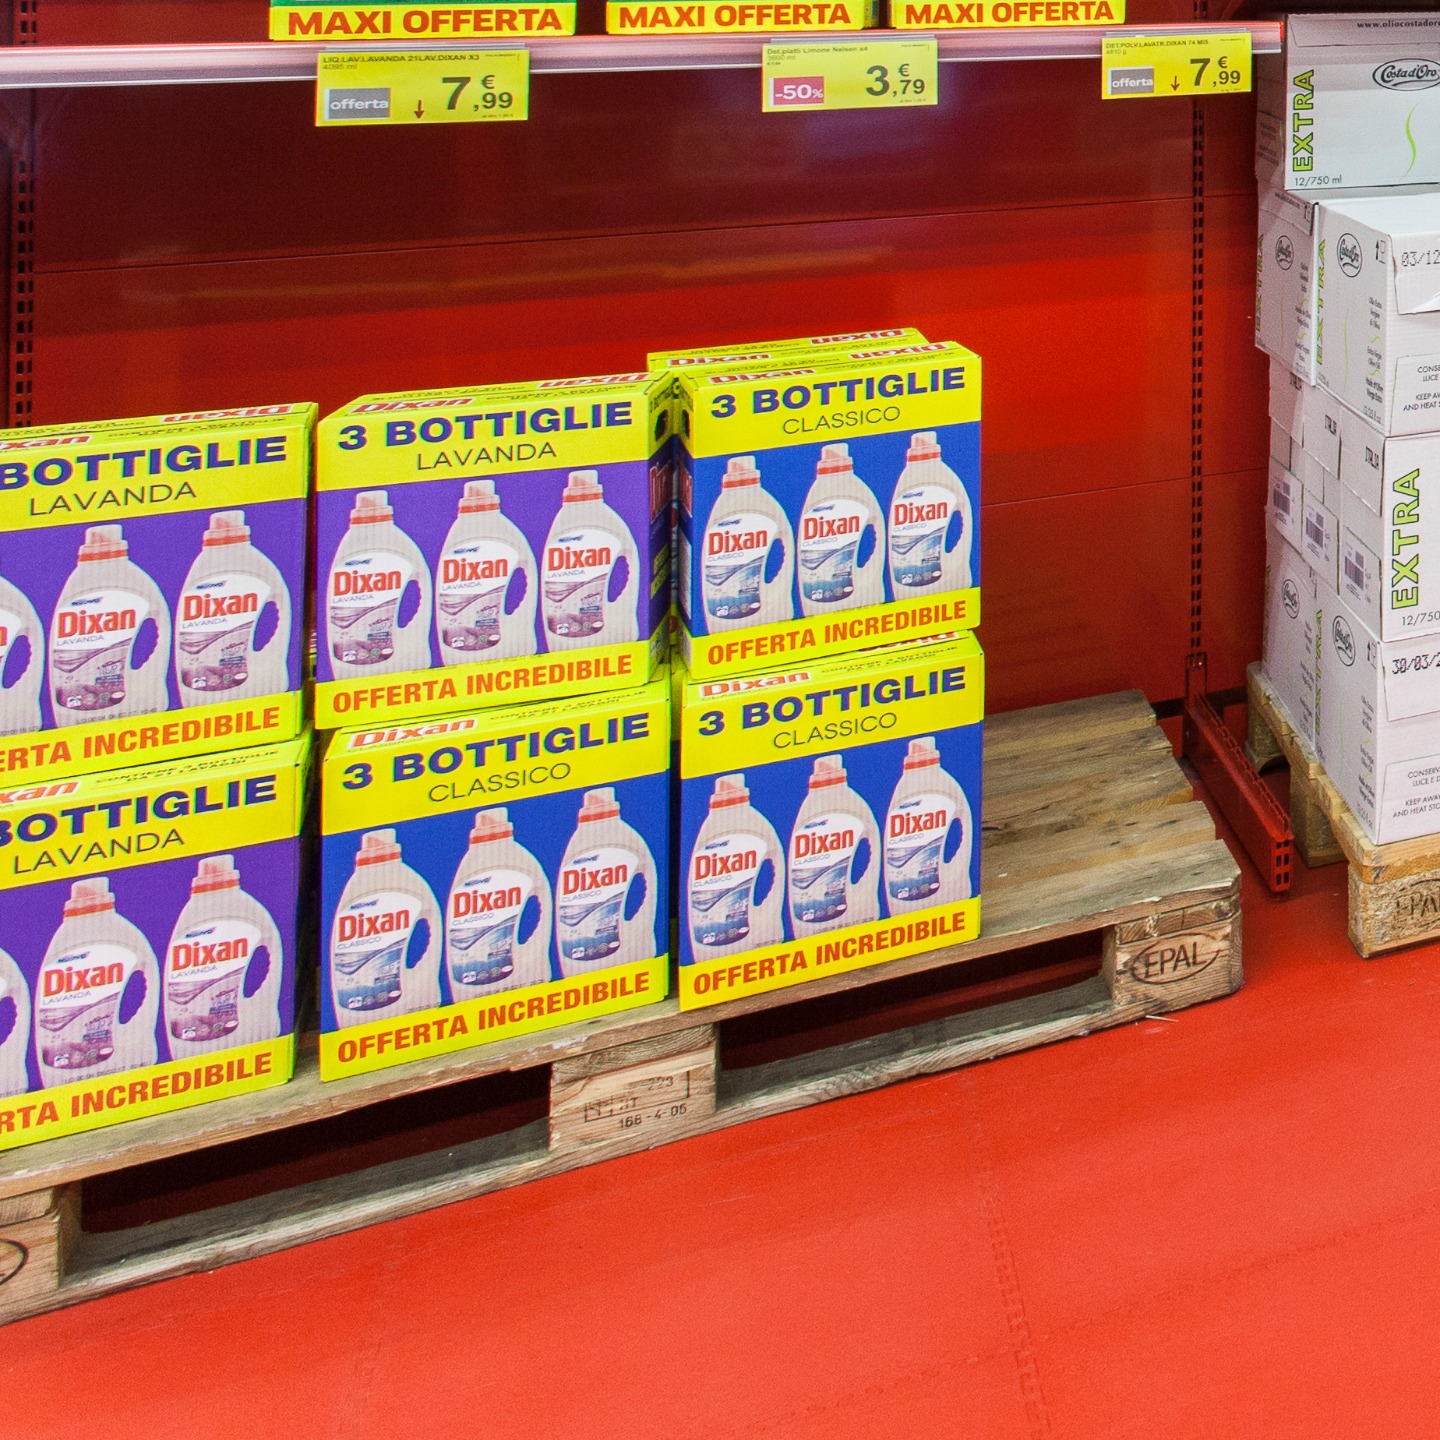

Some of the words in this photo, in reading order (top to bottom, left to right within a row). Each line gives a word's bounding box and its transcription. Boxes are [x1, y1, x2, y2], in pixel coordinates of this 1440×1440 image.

[288, 9, 392, 35] MAXI
[402, 7, 563, 34] OFFERTA
[905, 2, 984, 25] MAXI
[992, 0, 1115, 23] OFFERTA
[1111, 75, 1154, 90] offerta
[330, 98, 389, 110] offerta
[1292, 69, 1314, 173] EXTRA
[711, 394, 737, 420] 3
[752, 366, 966, 414] BOTTIGLIE
[782, 407, 902, 435] CLASSICO
[29, 479, 198, 517] LAVANDA
[708, 528, 768, 556] Dixan
[708, 627, 816, 666] OFFERTA
[824, 599, 967, 643] INCREDIBILE
[694, 950, 809, 995] OFFERTA
[815, 911, 967, 963] INCREDIBILE
[1143, 941, 1209, 980] EPAL
